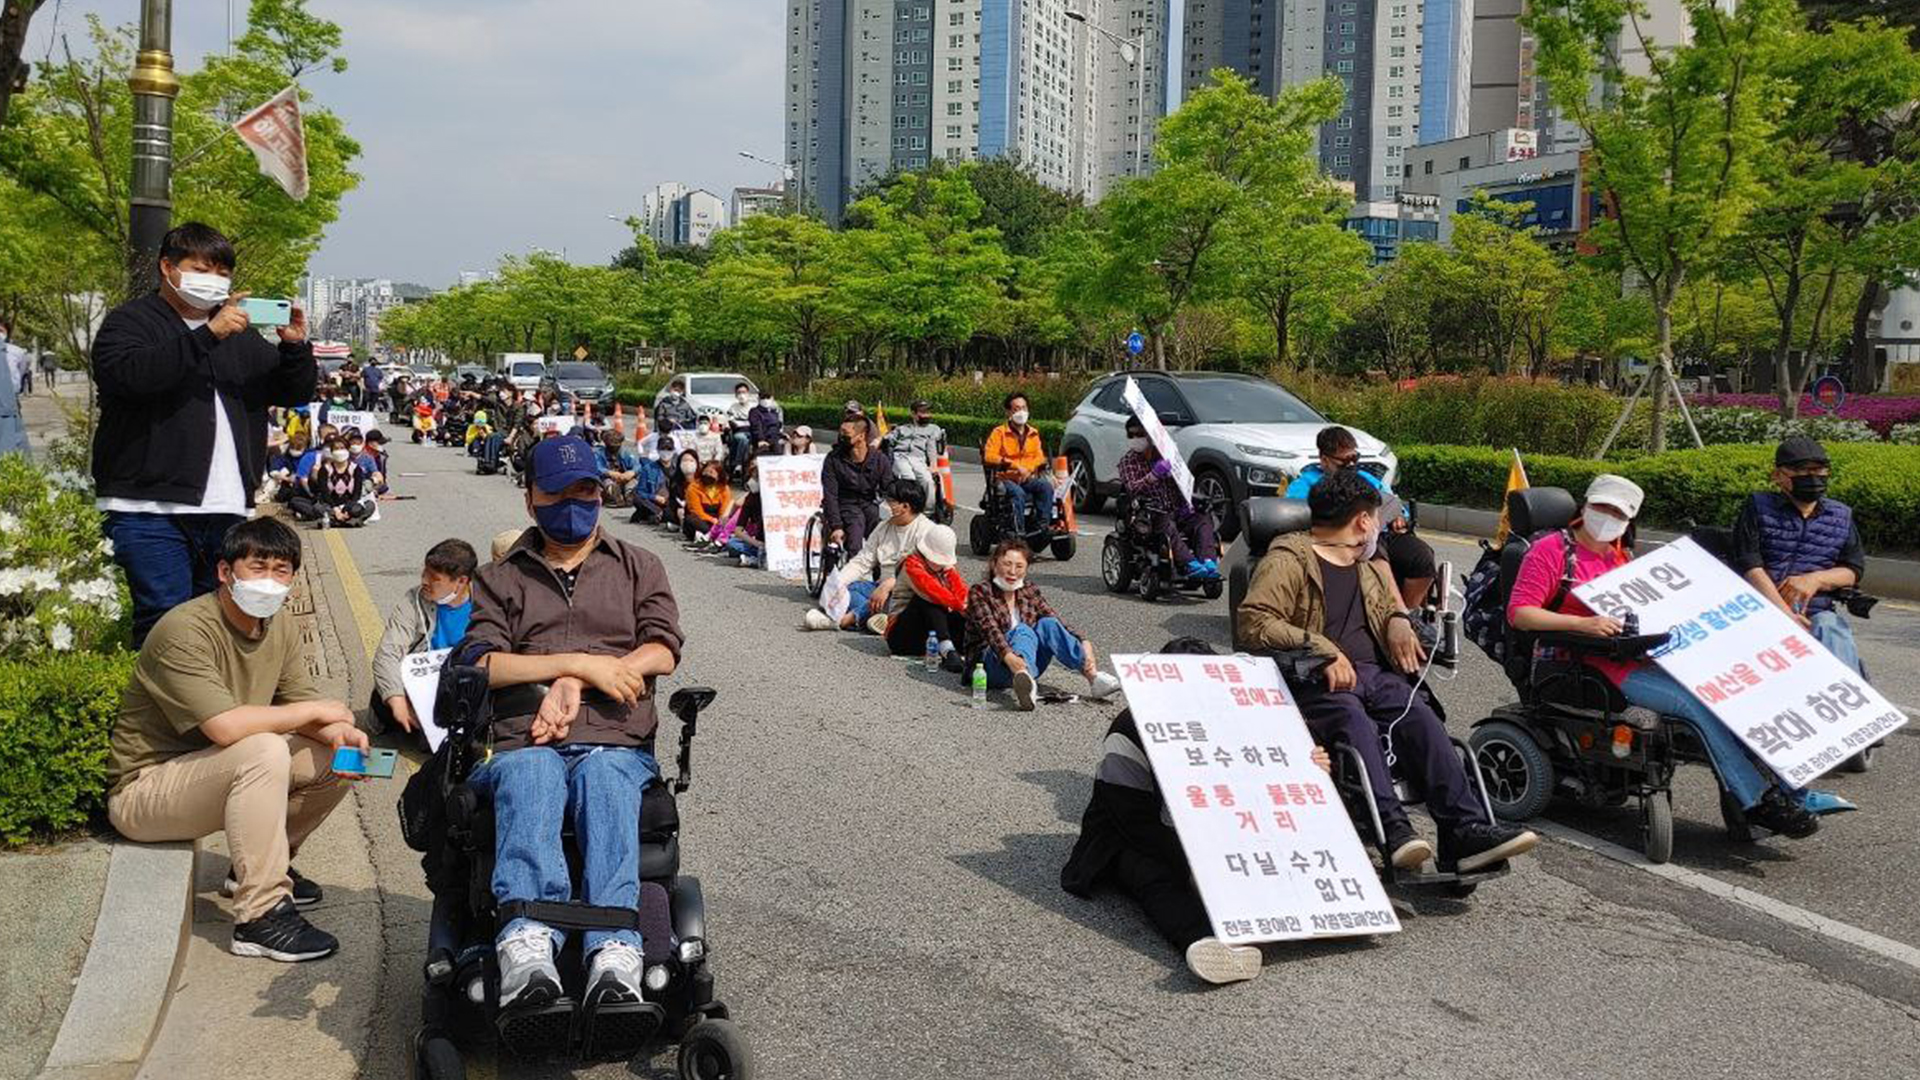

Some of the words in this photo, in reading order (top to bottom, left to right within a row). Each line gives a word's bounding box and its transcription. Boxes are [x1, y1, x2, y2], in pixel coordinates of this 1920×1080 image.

[1589, 562, 1692, 620] 장애인
[1121, 663, 1184, 683] 거리의
[1202, 663, 1243, 684] 턱을
[1696, 662, 1763, 704] 예산을
[1229, 687, 1287, 707] 없애고
[1144, 721, 1209, 743] 인도를
[1222, 919, 1254, 937] 전북
[1255, 915, 1302, 935] 장애인
